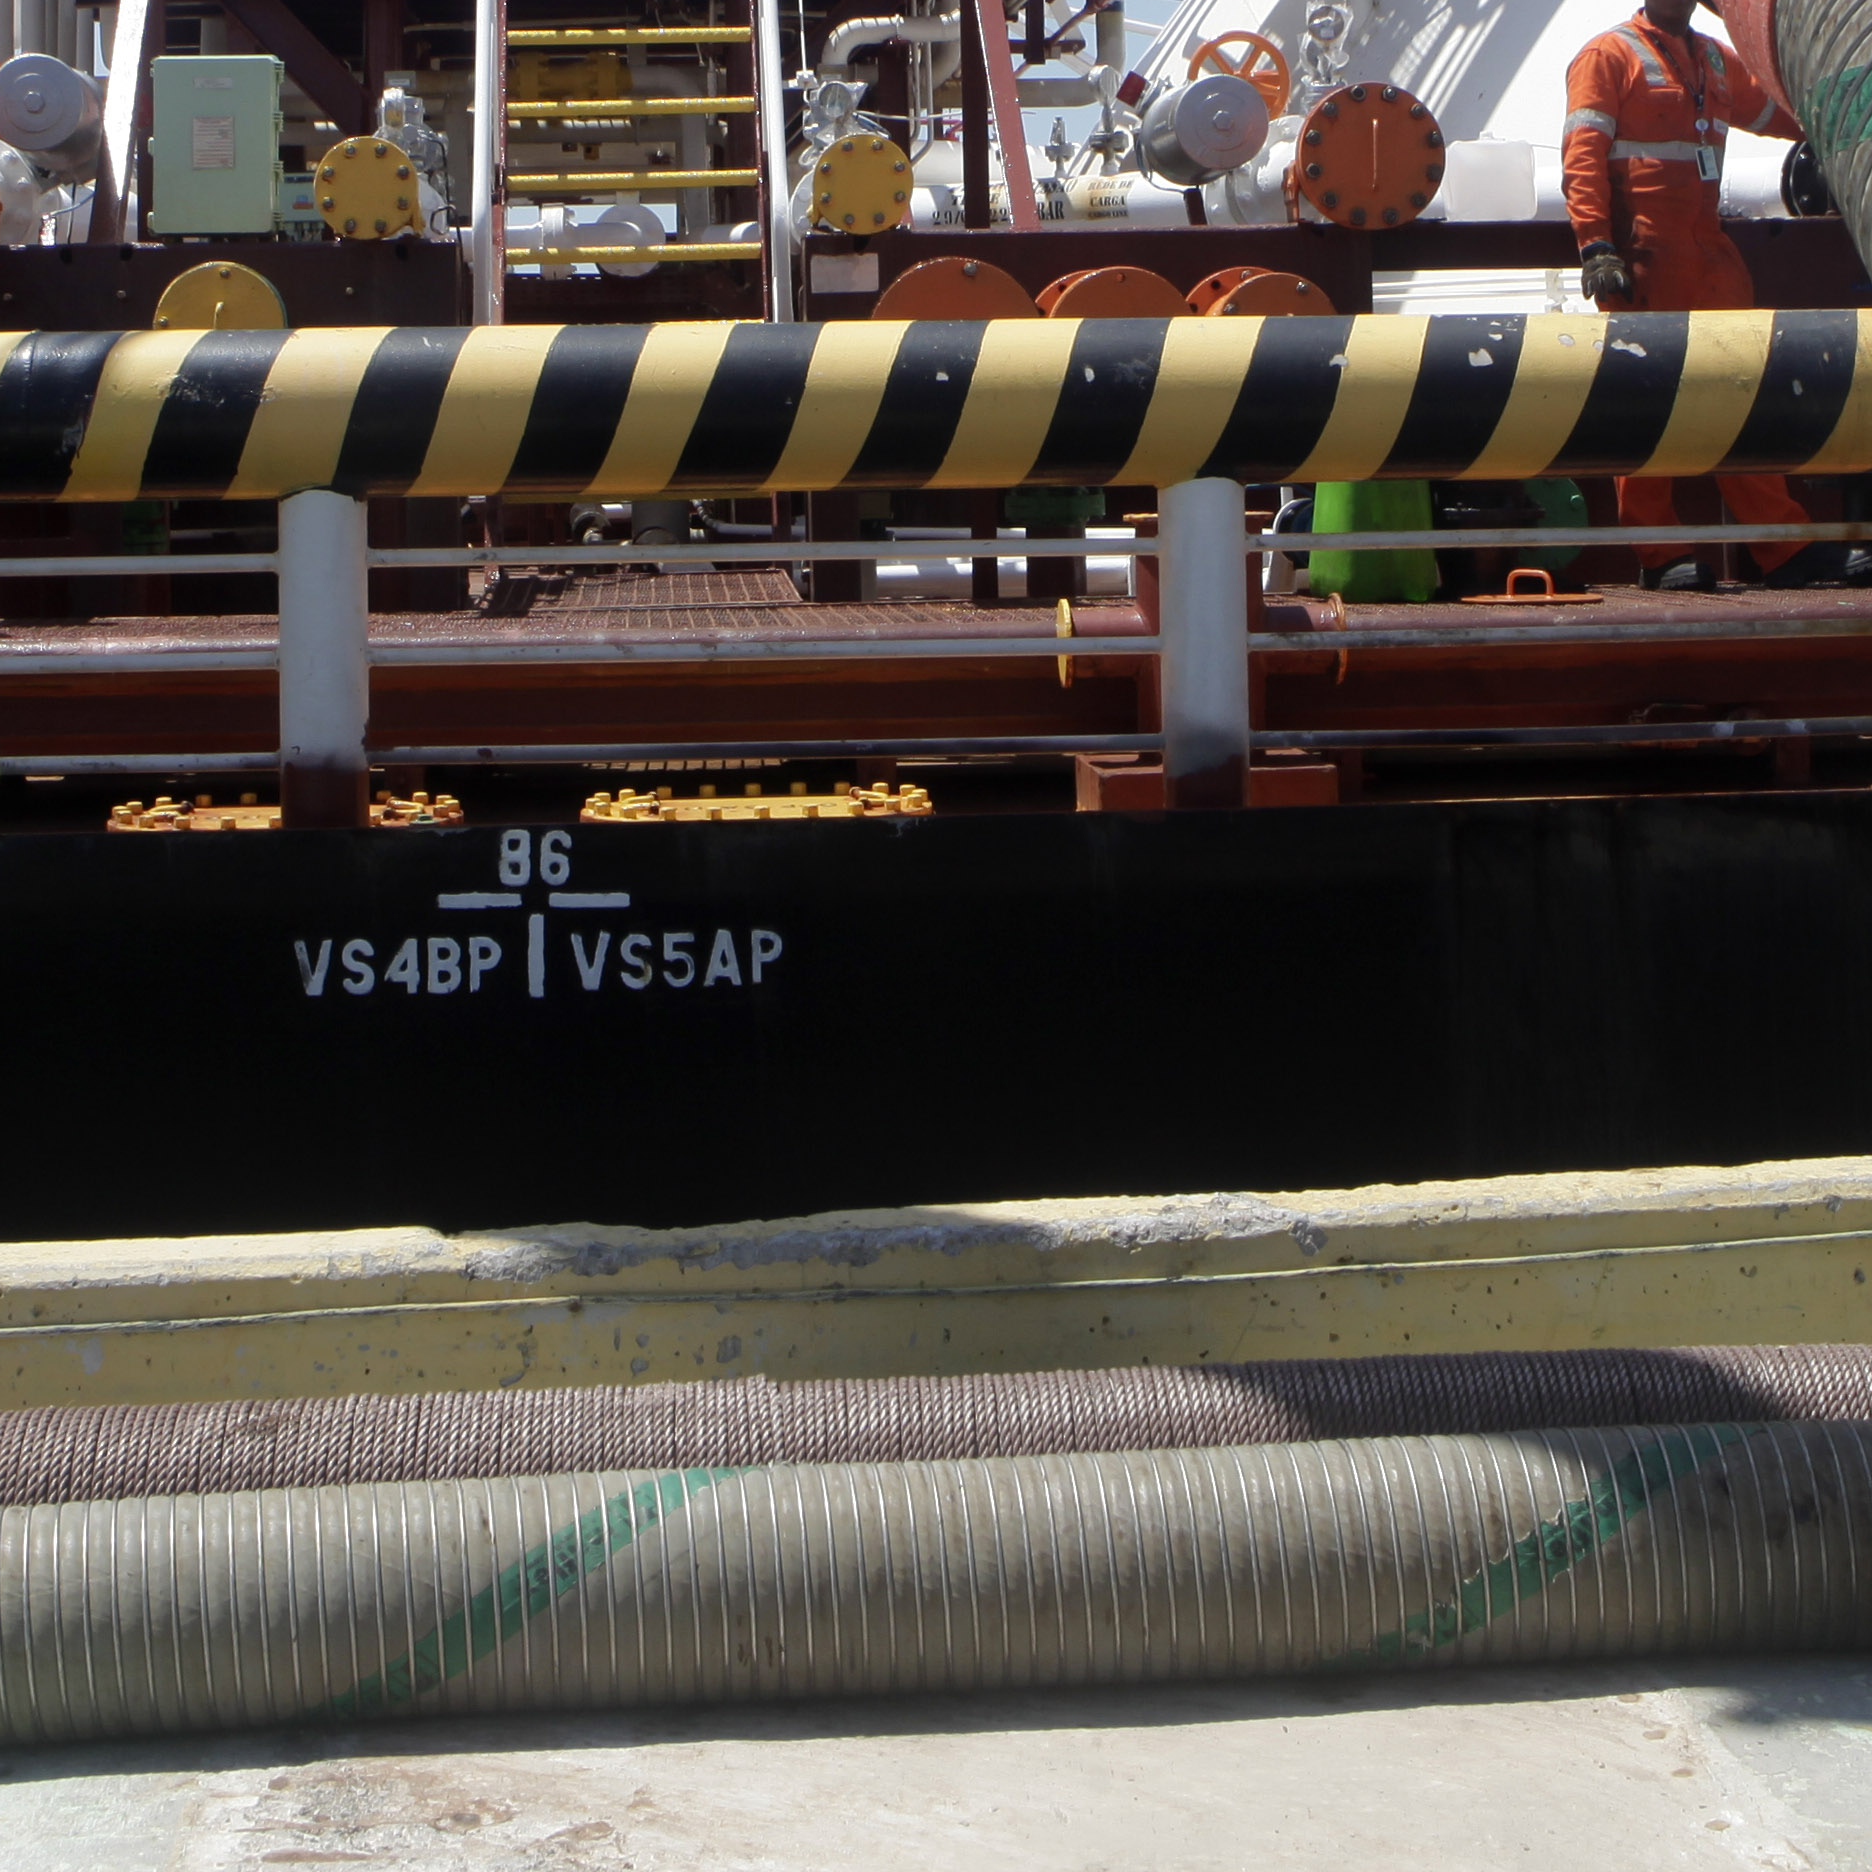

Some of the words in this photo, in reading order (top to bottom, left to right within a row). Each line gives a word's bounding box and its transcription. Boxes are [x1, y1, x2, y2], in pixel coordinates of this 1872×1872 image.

[498, 829, 574, 887] 86
[293, 935, 504, 997] VS4BP
[570, 928, 784, 993] VS5AP
